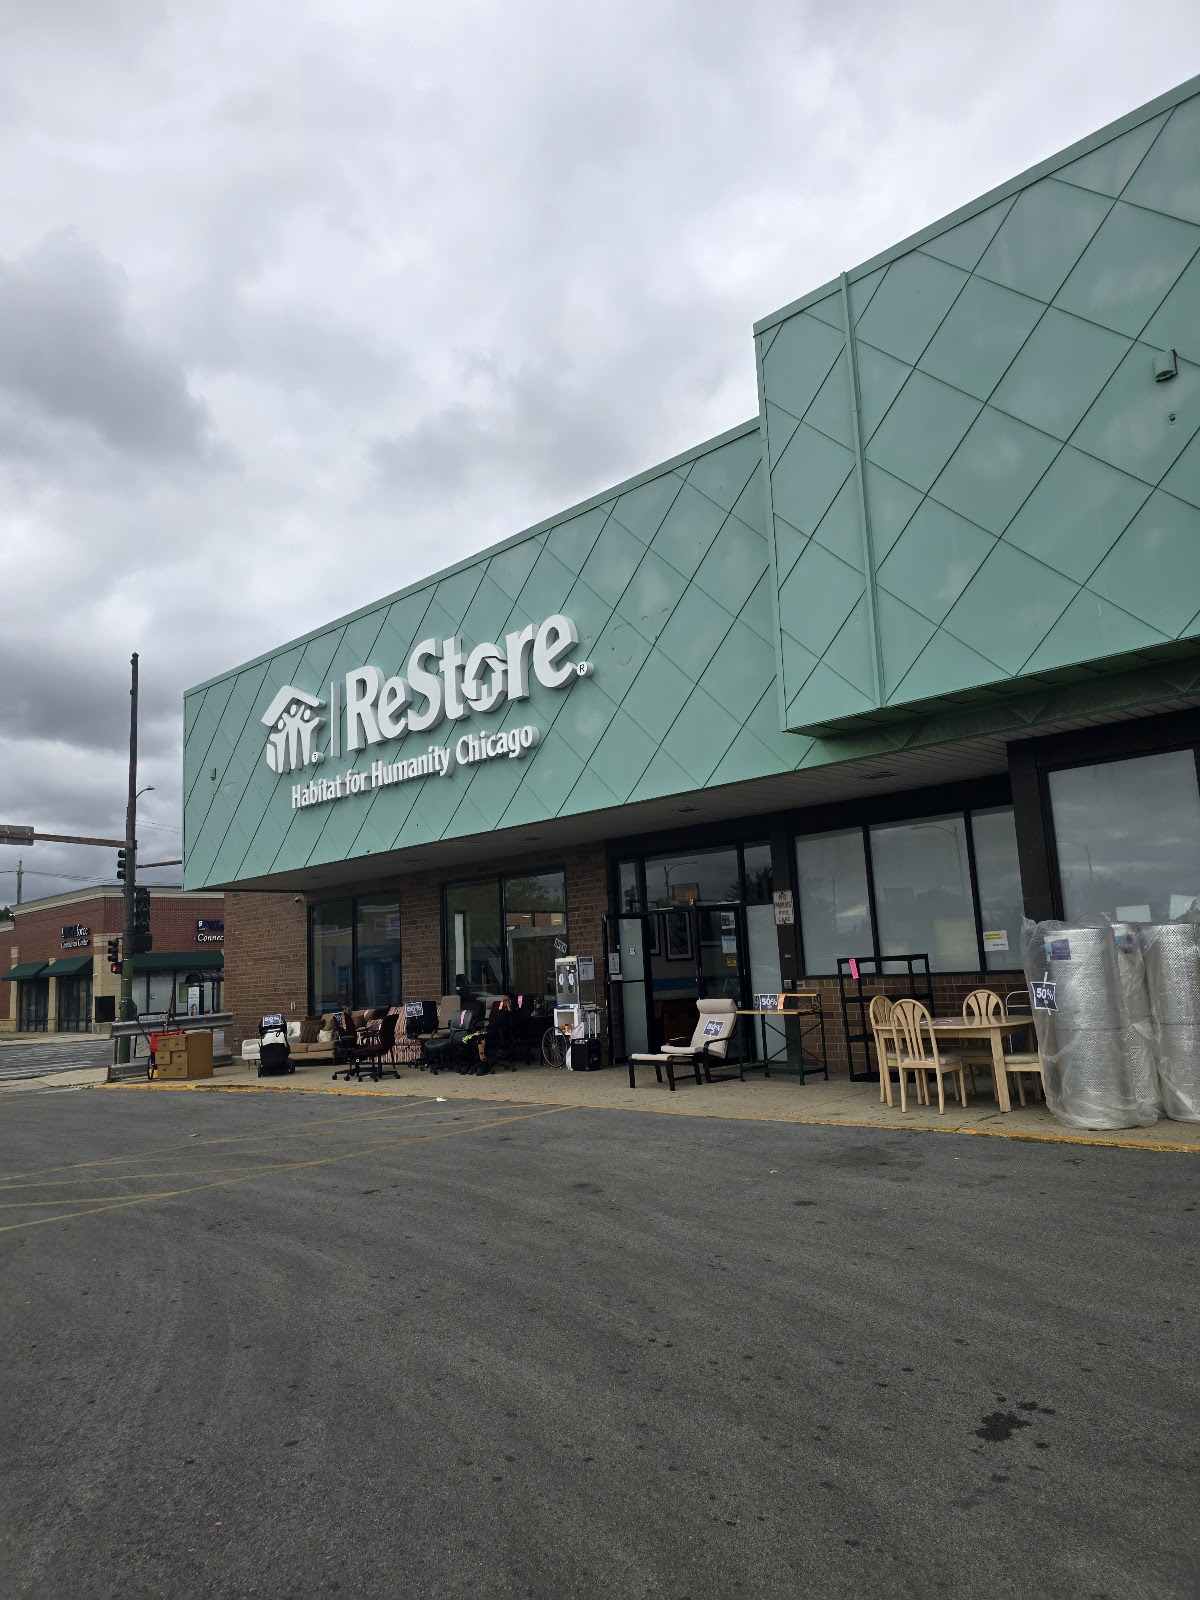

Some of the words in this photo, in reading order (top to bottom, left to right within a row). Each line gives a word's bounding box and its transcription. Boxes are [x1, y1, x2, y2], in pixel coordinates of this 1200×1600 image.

[292, 774, 342, 809] Habitat
[345, 768, 370, 795] for
[371, 745, 451, 788] Humanity
[455, 725, 534, 765] Chicago
[779, 893, 787, 901] NO
[198, 933, 224, 942] Connec
[1036, 987, 1053, 1000] 50%
[761, 997, 778, 1005] 50%
[707, 1023, 721, 1031] 50%
